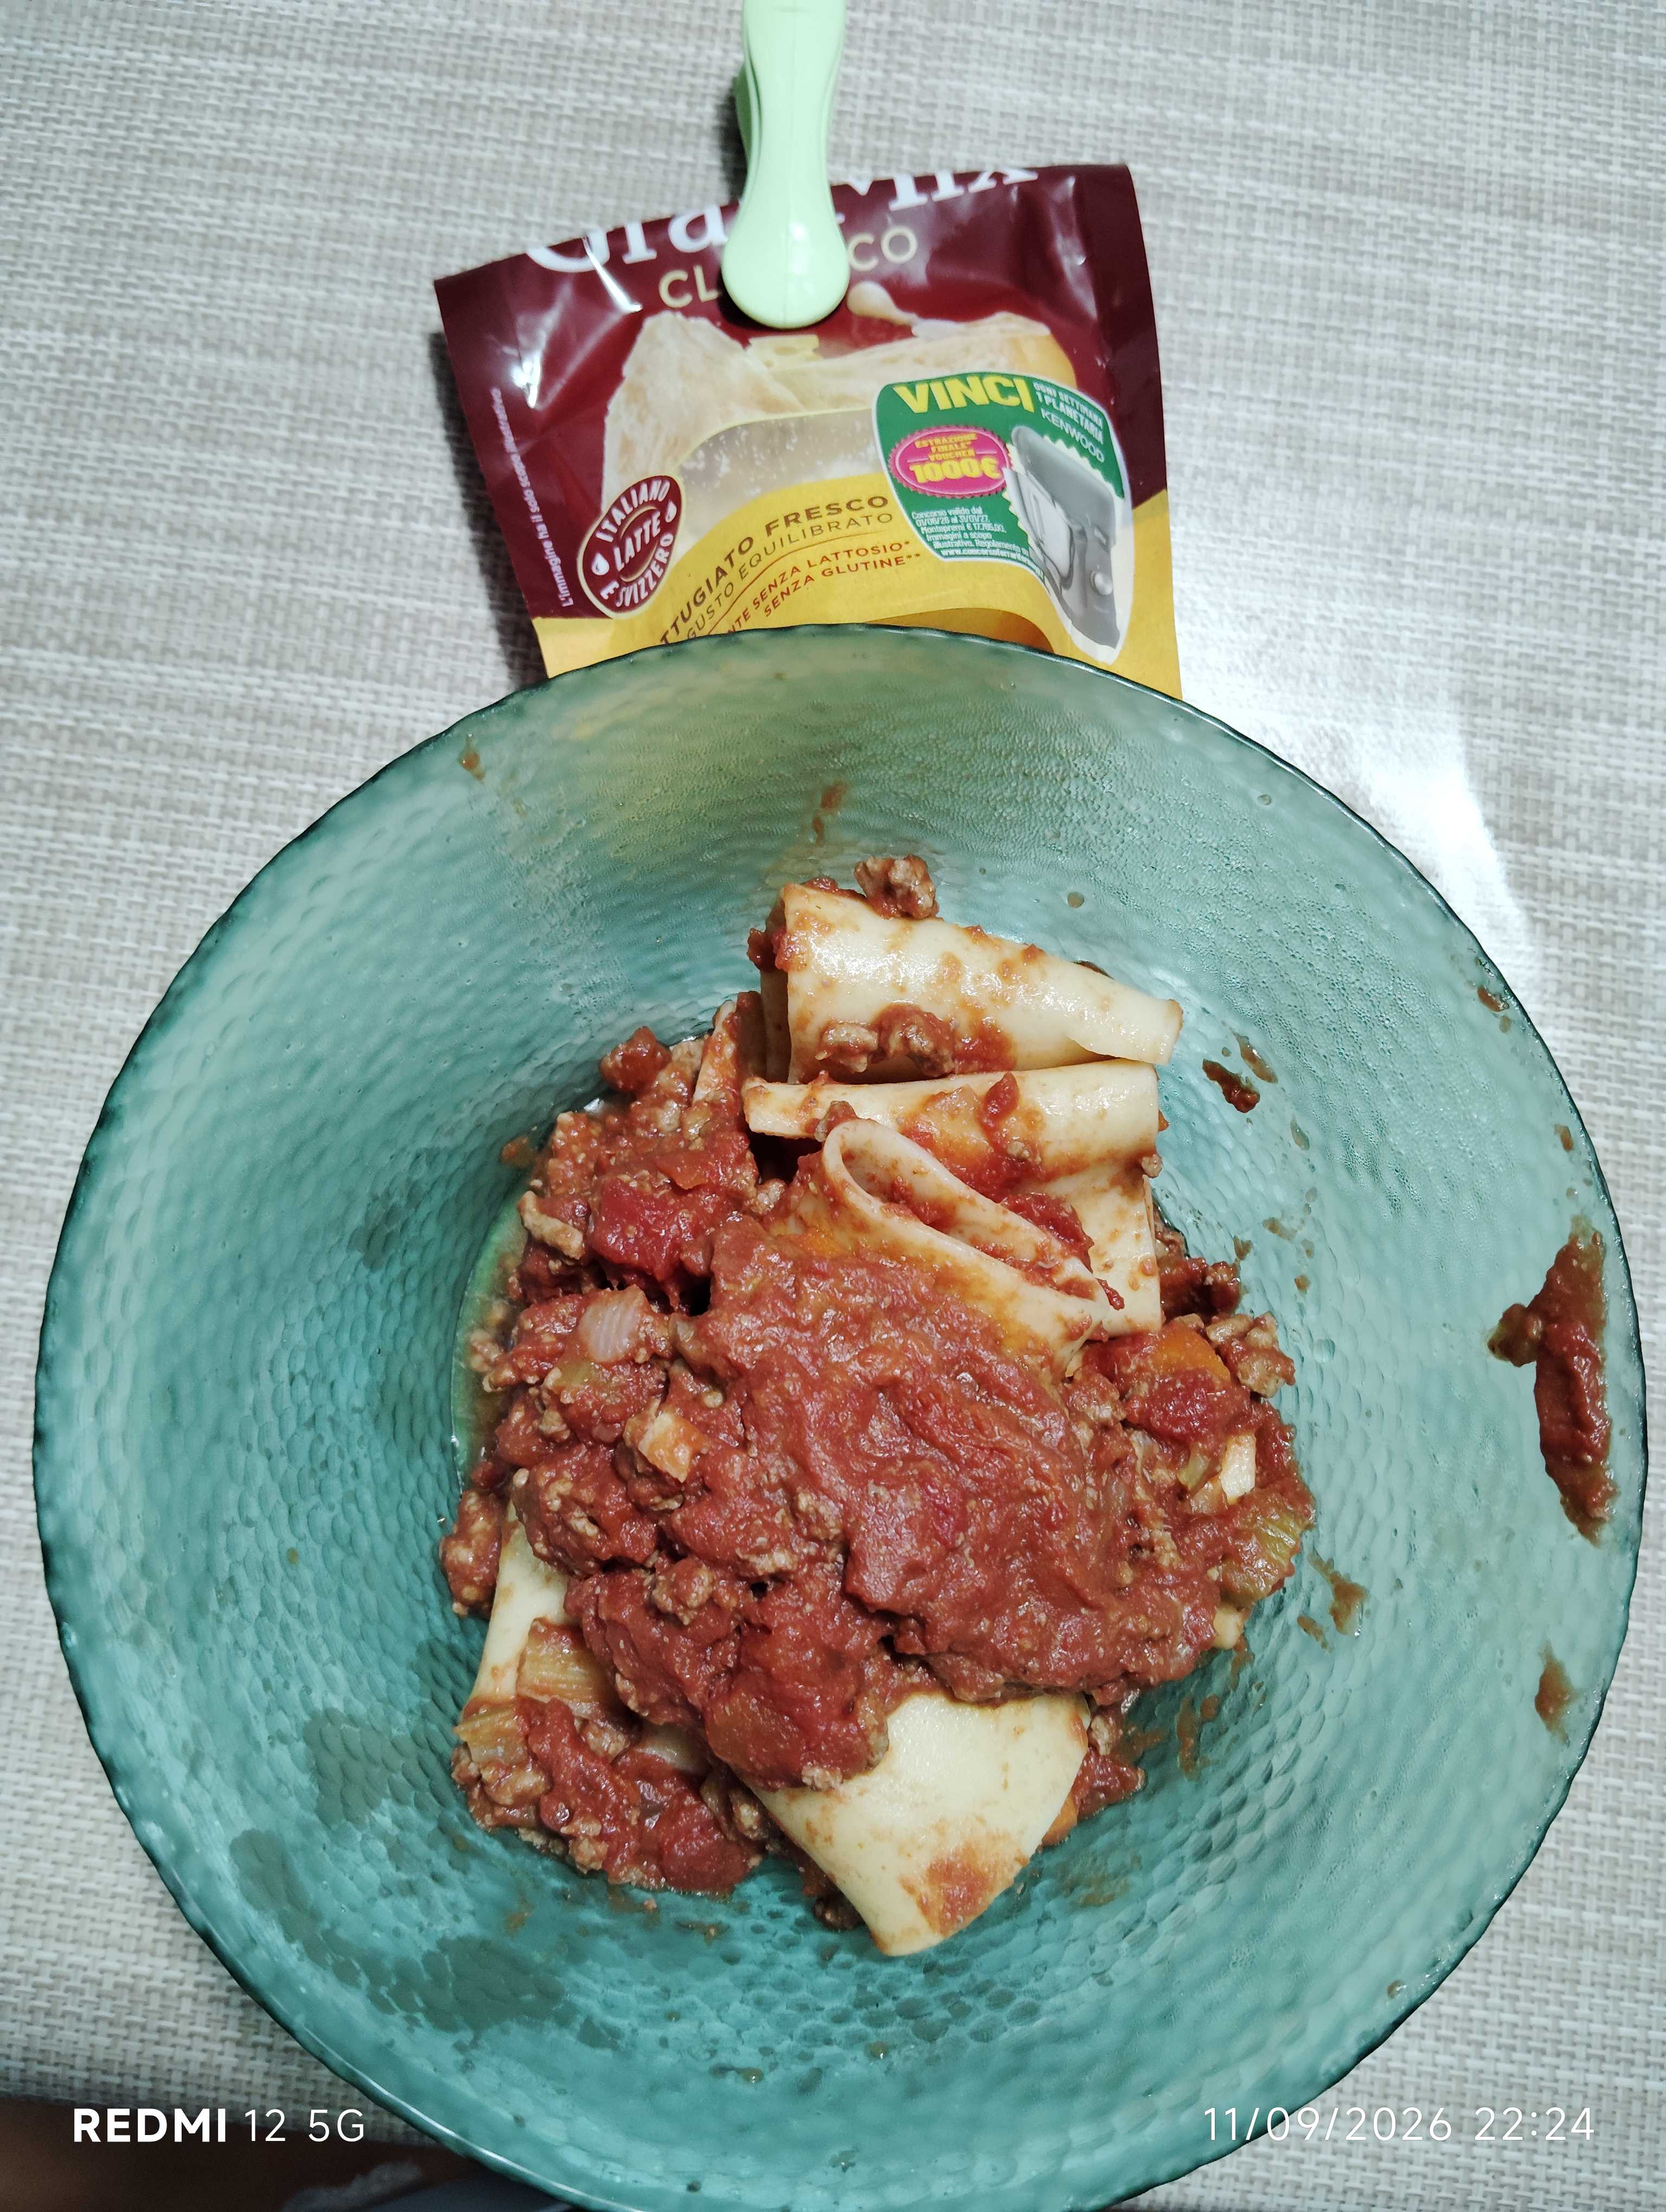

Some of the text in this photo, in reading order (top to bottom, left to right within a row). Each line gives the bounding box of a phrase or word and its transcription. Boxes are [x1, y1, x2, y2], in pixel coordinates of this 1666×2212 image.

[658, 226, 918, 308] CLCO
[893, 375, 1034, 413] VINCI
[1036, 391, 1103, 445] 1 PLANETARIA
[1041, 407, 1105, 462] KENWOOD
[914, 432, 977, 448] ESTRAZIONE
[928, 449, 975, 461] VOUCHER
[908, 456, 1001, 484] 1000€
[523, 488, 540, 513] solo
[530, 513, 543, 523] il
[595, 479, 670, 542] ITALIANO
[912, 506, 983, 519] Concorso valido dal
[535, 523, 549, 539] ha
[613, 511, 661, 571] LATTE
[920, 524, 965, 534] Montepremi
[926, 532, 962, 542] Immagini
[975, 539, 1021, 553] Regolamento
[542, 539, 573, 607] L'immagine
[600, 533, 674, 607] E SVIZZERO
[660, 496, 888, 644] TTUGIATO FRESCO
[687, 512, 893, 640] GUSTO EQUILIBRATO
[753, 565, 802, 610] SENZA
[764, 575, 815, 618] SENZA
